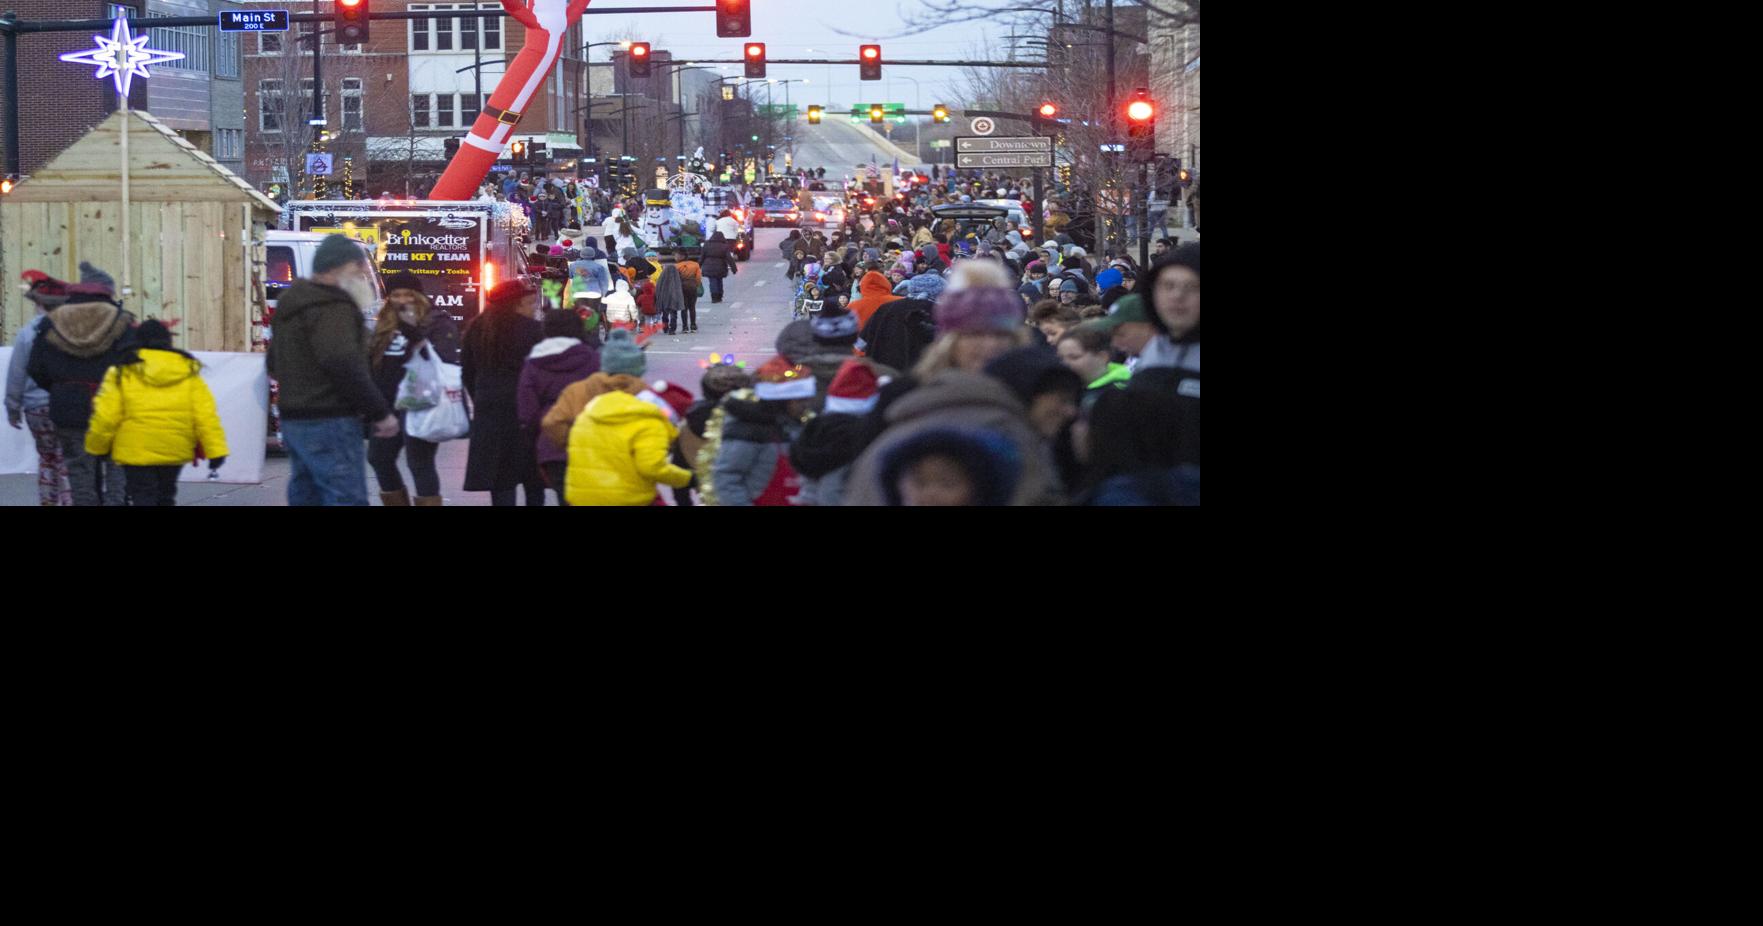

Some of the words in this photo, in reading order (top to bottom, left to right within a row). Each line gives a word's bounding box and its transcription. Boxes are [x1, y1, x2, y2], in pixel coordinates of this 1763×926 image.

[232, 13, 261, 22] Main
[263, 13, 275, 22] St
[990, 140, 1046, 149] Downtown
[982, 155, 1020, 165] Central
[1023, 155, 1046, 164] Park
[387, 231, 469, 245] Brinkoetter
[387, 252, 408, 261] THE
[411, 252, 434, 261] KEY
[437, 252, 470, 261] TEAM
